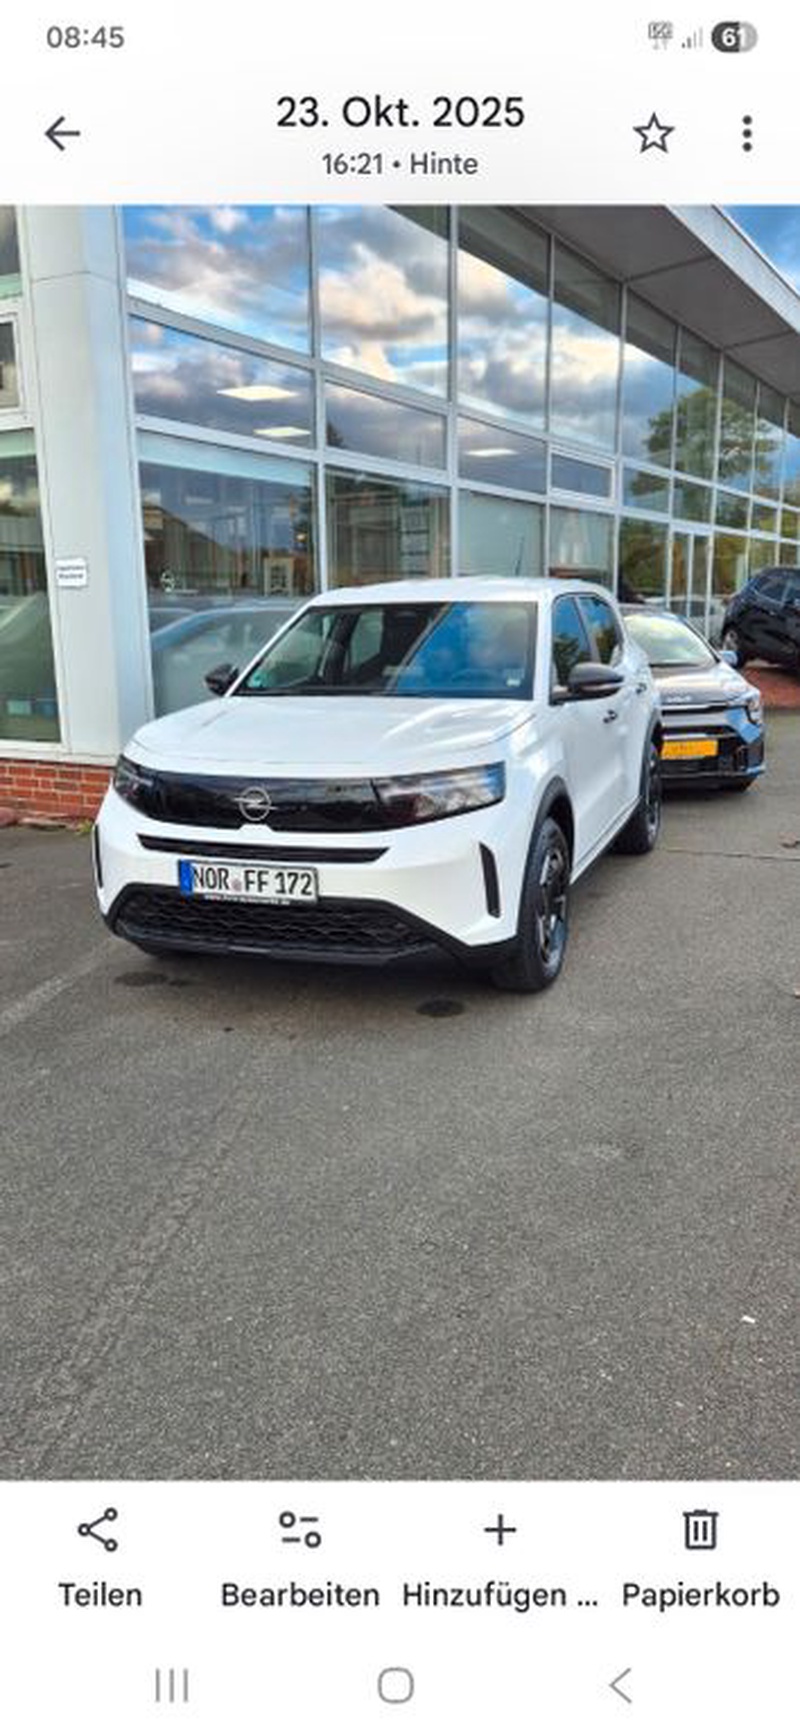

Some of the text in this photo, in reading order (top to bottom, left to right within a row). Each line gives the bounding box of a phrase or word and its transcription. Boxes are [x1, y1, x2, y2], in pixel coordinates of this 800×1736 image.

[192, 866, 313, 896] NOR FF 172
